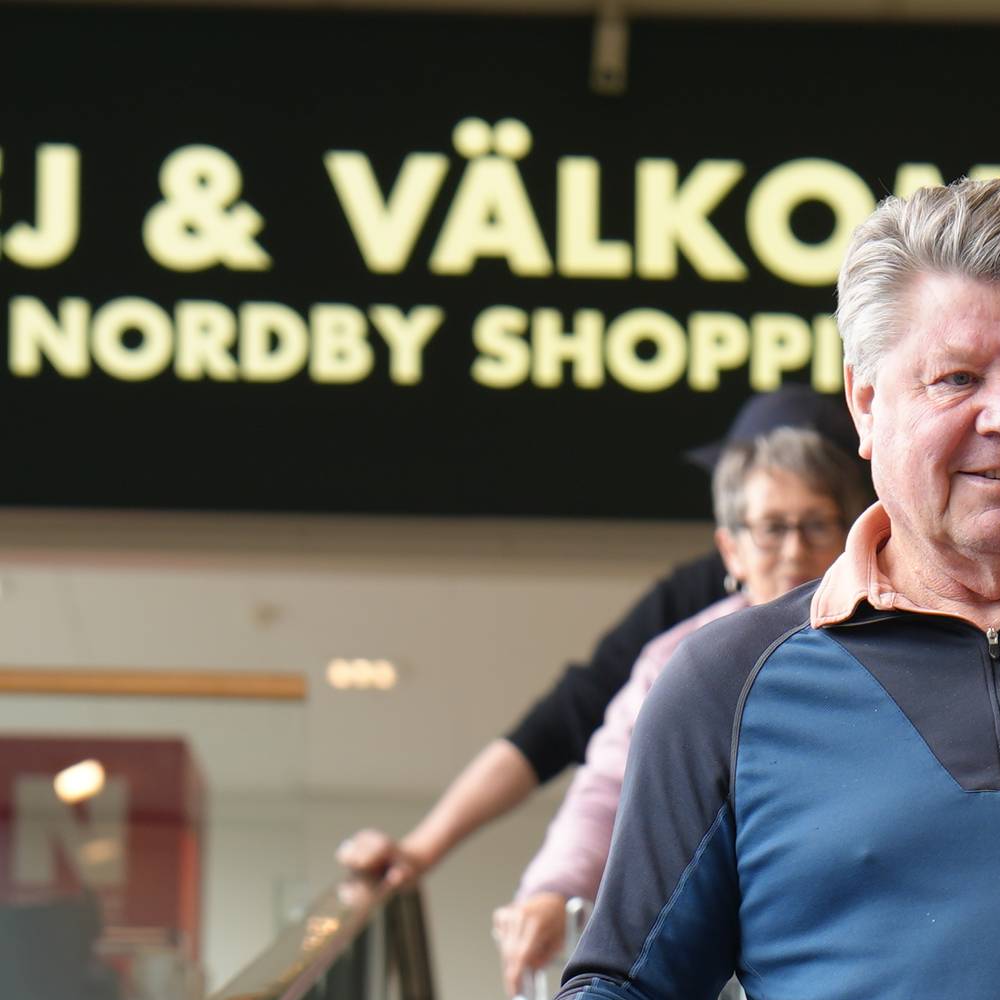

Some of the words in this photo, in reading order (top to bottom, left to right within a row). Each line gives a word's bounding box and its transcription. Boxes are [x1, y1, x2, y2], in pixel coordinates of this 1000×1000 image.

[0, 144, 80, 268] J
[142, 144, 270, 270] &
[9, 296, 441, 385] NORDBY
